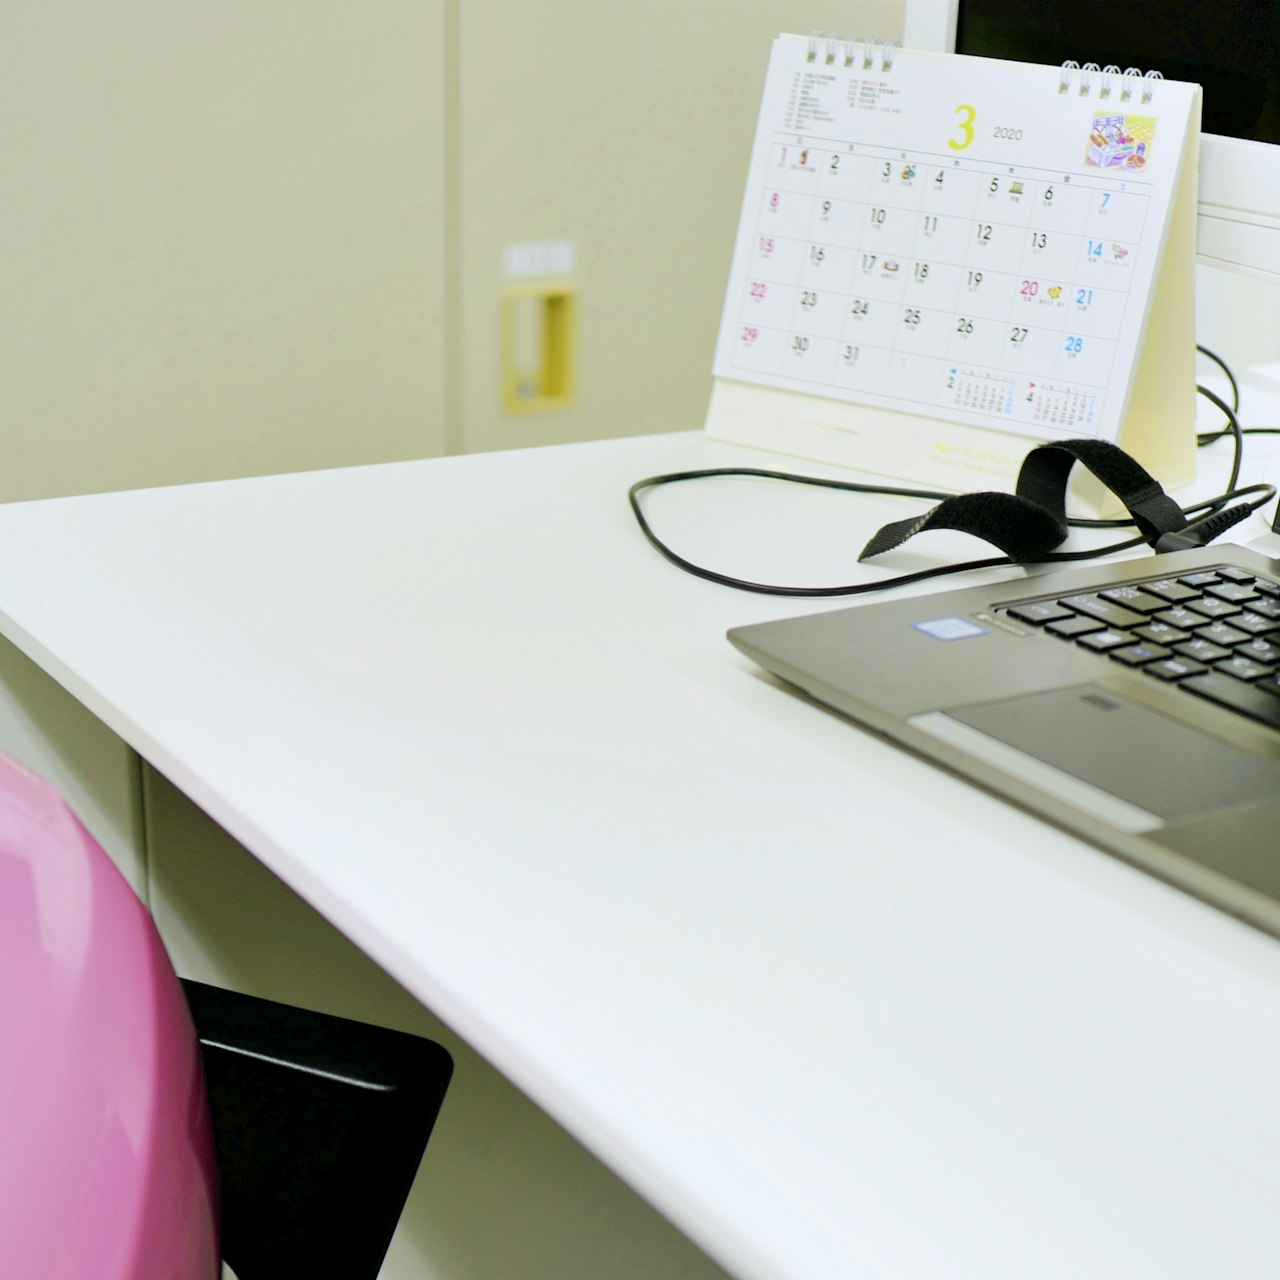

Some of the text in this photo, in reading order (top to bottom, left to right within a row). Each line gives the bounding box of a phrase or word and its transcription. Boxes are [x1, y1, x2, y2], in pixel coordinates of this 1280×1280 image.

[948, 104, 976, 150] 3
[993, 126, 1023, 141] 2020
[830, 155, 840, 169] 2
[882, 162, 891, 177] 3
[935, 170, 944, 184] 4
[990, 177, 999, 192] 5
[1044, 186, 1053, 200] 6
[1101, 193, 1110, 208] 7
[770, 192, 1103, 257] 8 9 10 11 12 13 14
[759, 237, 774, 253] 15
[810, 246, 825, 262] 16
[861, 254, 876, 270] 17
[913, 262, 929, 279] 18
[967, 271, 983, 288] 19
[1020, 279, 1039, 296] 20
[1076, 288, 1093, 305] 21
[741, 327, 758, 342] 29
[792, 335, 809, 352] 30
[843, 345, 860, 361] 31
[750, 282, 1083, 353] 22 23 24 25 26 27 28
